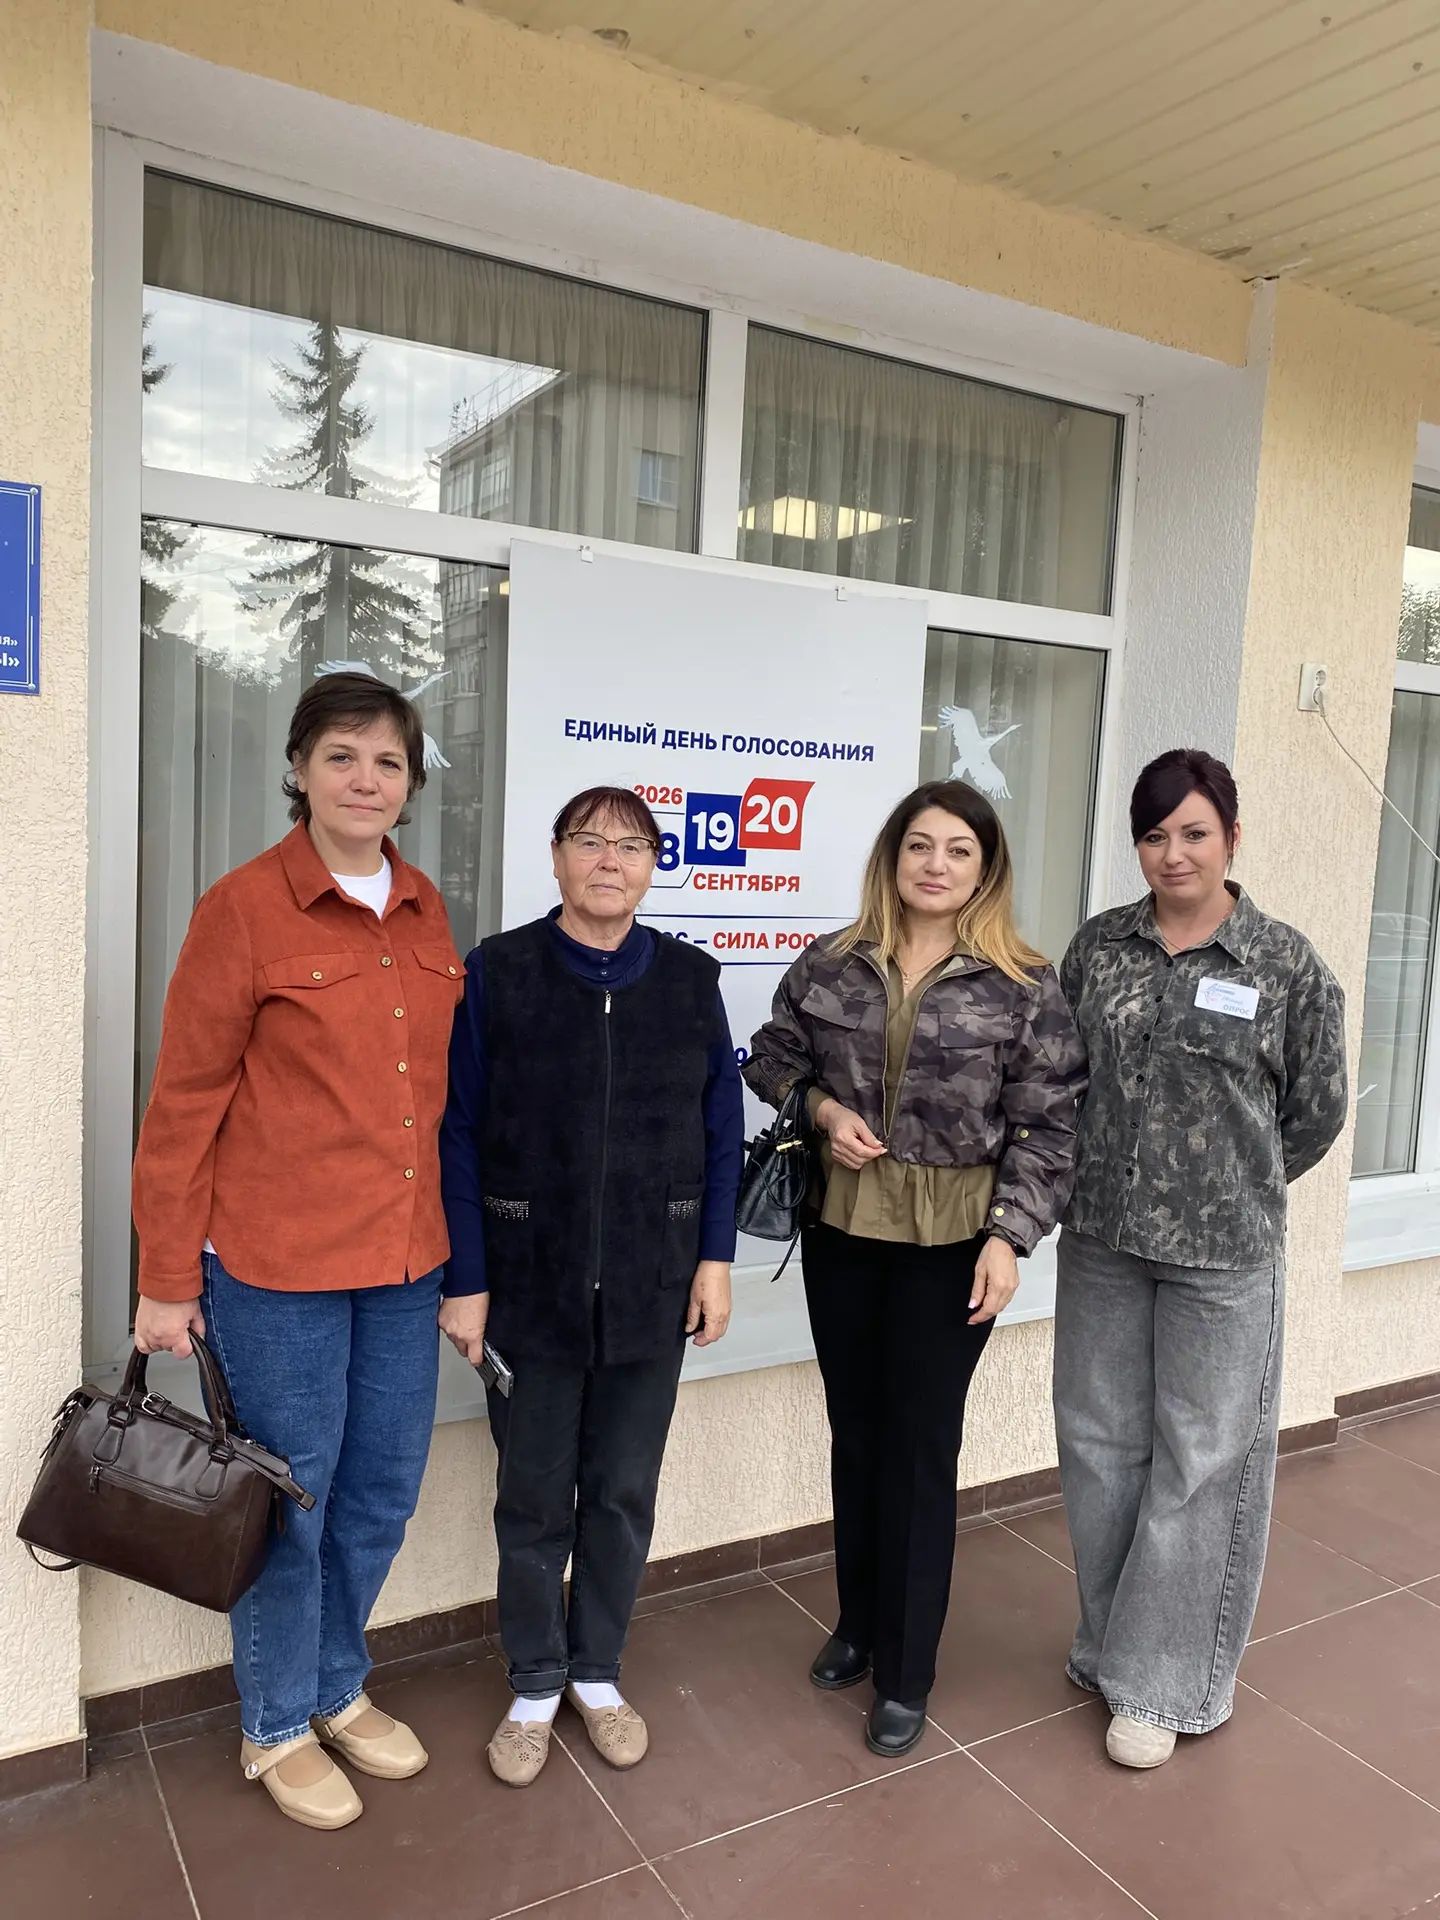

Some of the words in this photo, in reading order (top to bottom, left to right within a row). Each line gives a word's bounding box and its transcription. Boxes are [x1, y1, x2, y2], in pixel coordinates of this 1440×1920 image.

[564, 718, 657, 745] ЕДИНЫЙ
[661, 729, 718, 750] ДЕНЬ
[721, 734, 875, 762] ГОЛОСОВАНИЯ
[634, 785, 683, 805] 2026
[691, 811, 735, 851] 19
[745, 794, 799, 834] 20
[693, 872, 801, 893] СЕНТЯБРЯ
[713, 932, 770, 949] СИЛА
